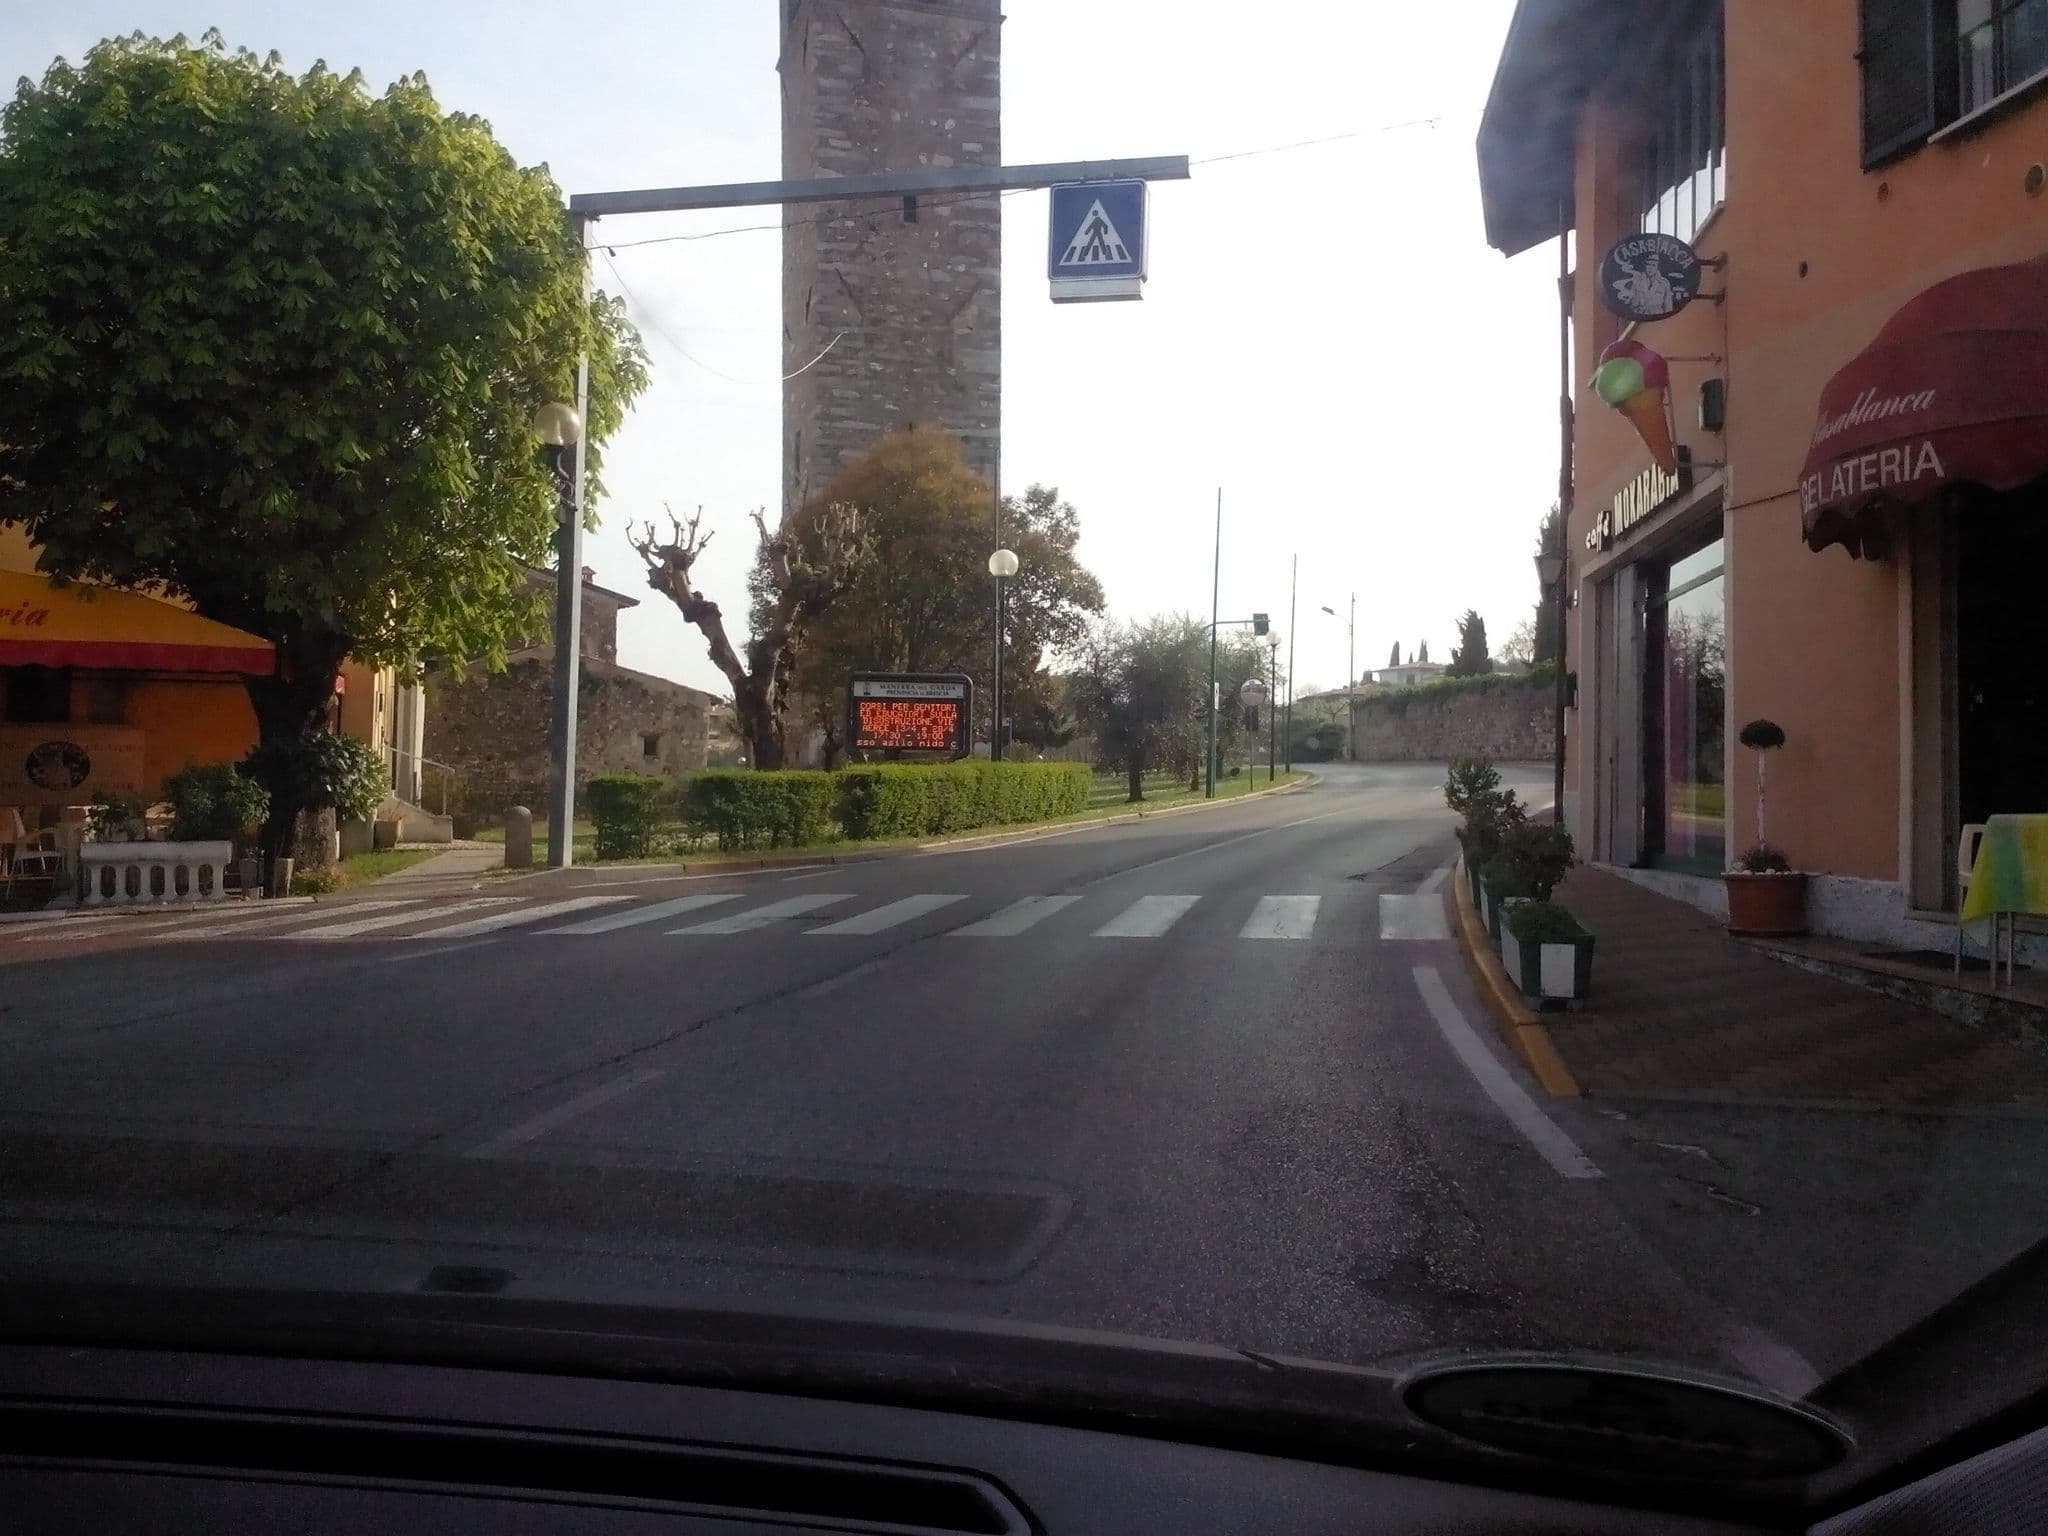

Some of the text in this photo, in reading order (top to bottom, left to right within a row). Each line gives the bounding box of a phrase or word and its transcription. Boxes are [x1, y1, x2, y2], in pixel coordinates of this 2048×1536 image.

[1801, 440, 1946, 514] GELATERIA
[1614, 463, 1679, 536] MOKARABIA
[860, 702, 887, 710] CORSI
[914, 703, 957, 711] GENITORI
[876, 710, 924, 718] EDUCATORI
[931, 711, 957, 719] SULLA
[863, 717, 933, 725] DISOSTRUZIONE
[919, 739, 944, 747] nido
